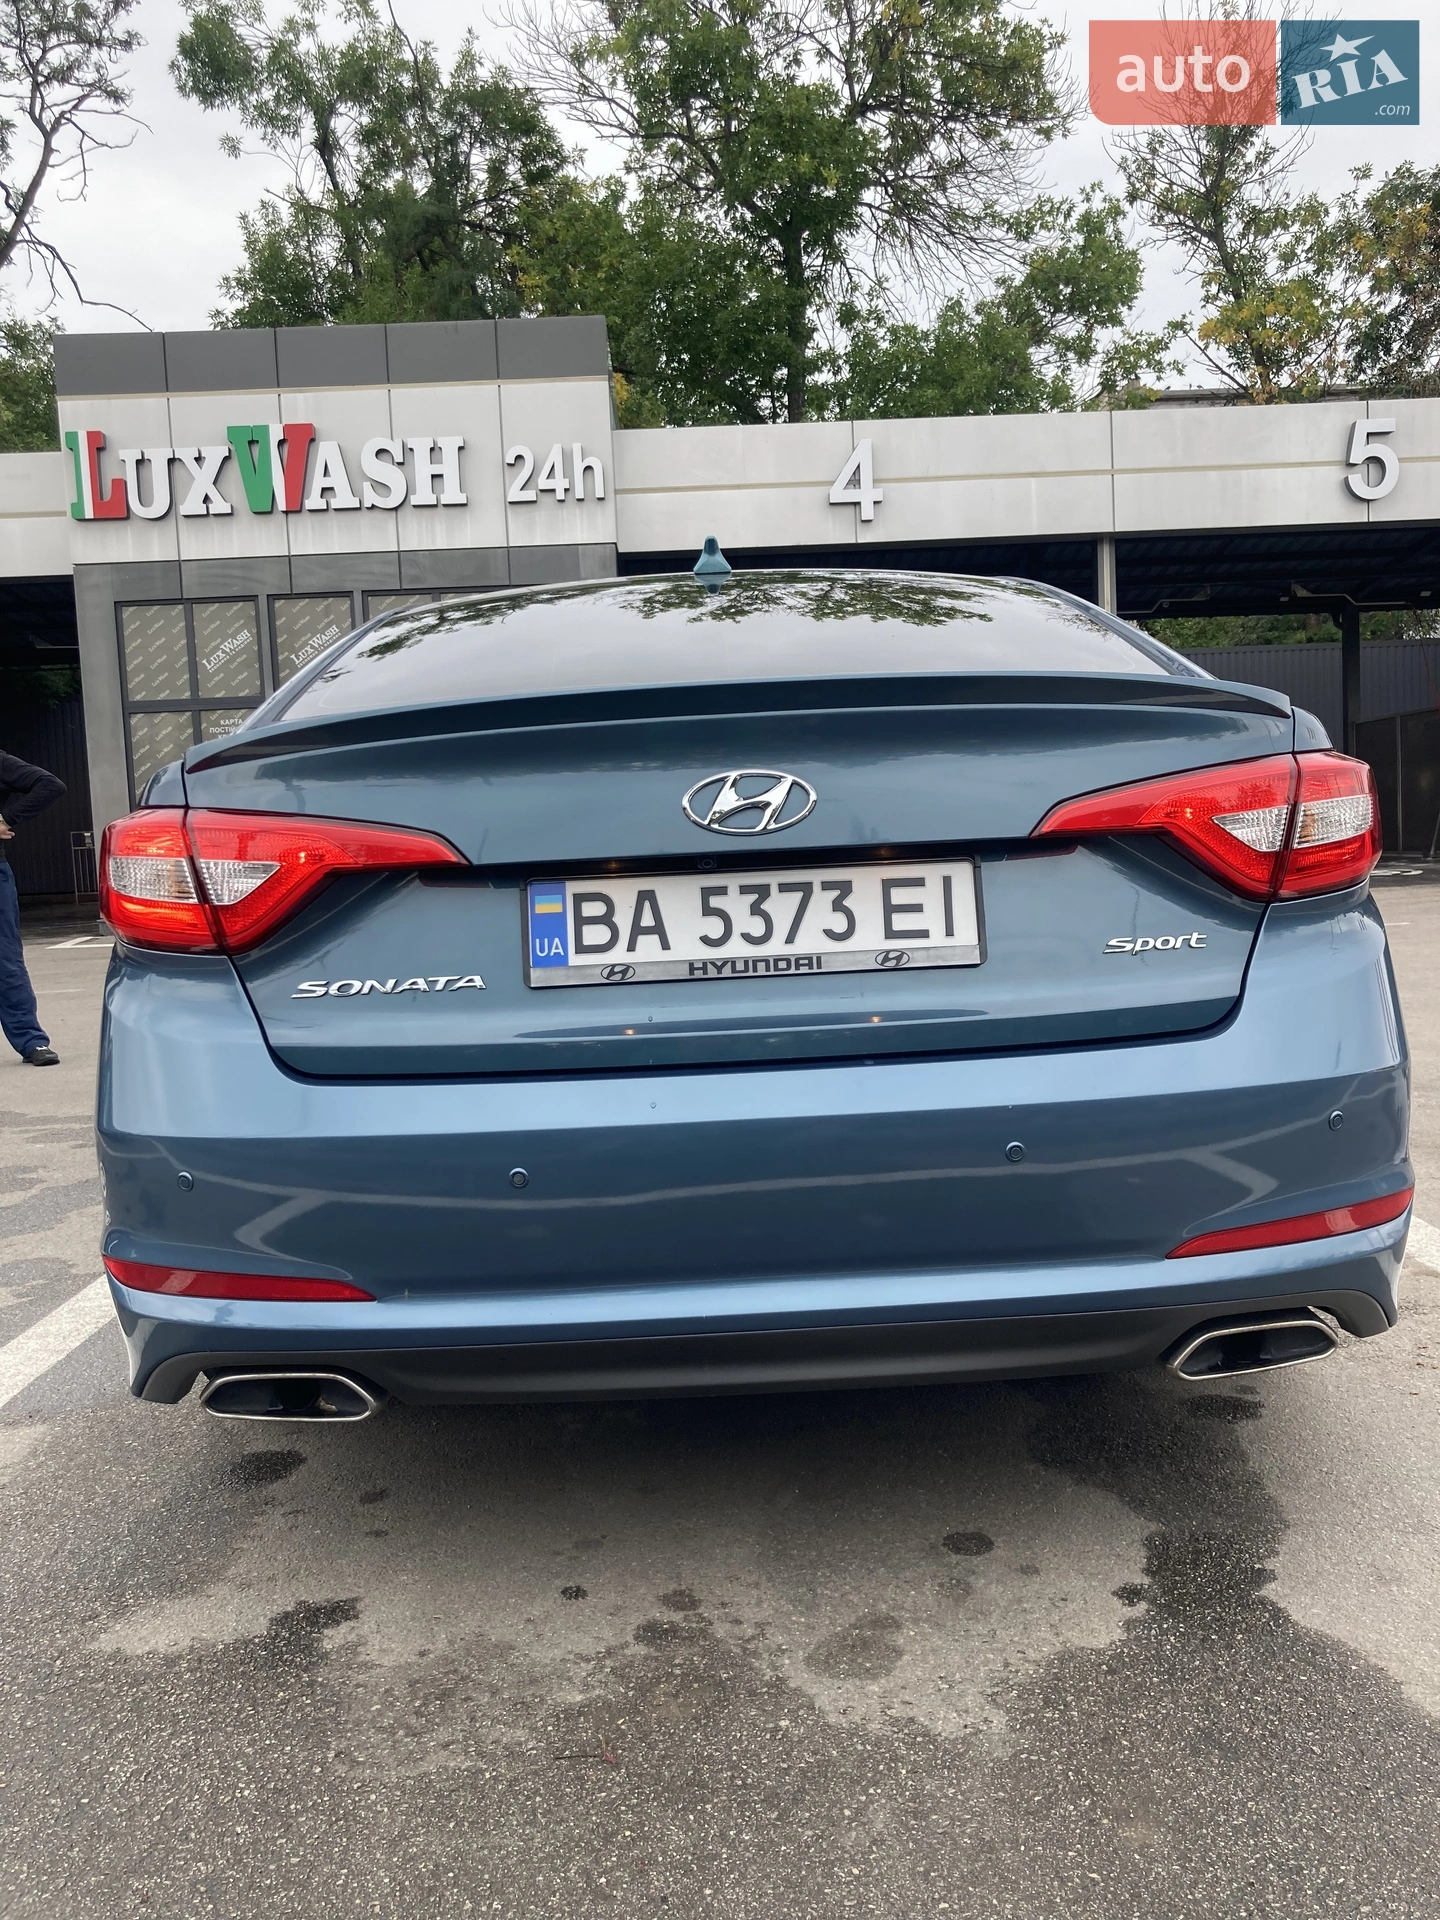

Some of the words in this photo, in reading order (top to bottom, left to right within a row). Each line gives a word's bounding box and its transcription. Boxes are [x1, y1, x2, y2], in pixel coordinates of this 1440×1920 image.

[1344, 418, 1400, 501] 5
[506, 442, 605, 505] 24h
[829, 438, 883, 522] 4
[209, 725, 236, 734] ПОСТІЙ
[573, 889, 672, 954] BA
[699, 880, 856, 948] 5373
[536, 938, 565, 957] UA
[1103, 931, 1208, 955] Sport
[689, 955, 823, 977] HYUNDAI
[290, 975, 487, 999] SONATA
